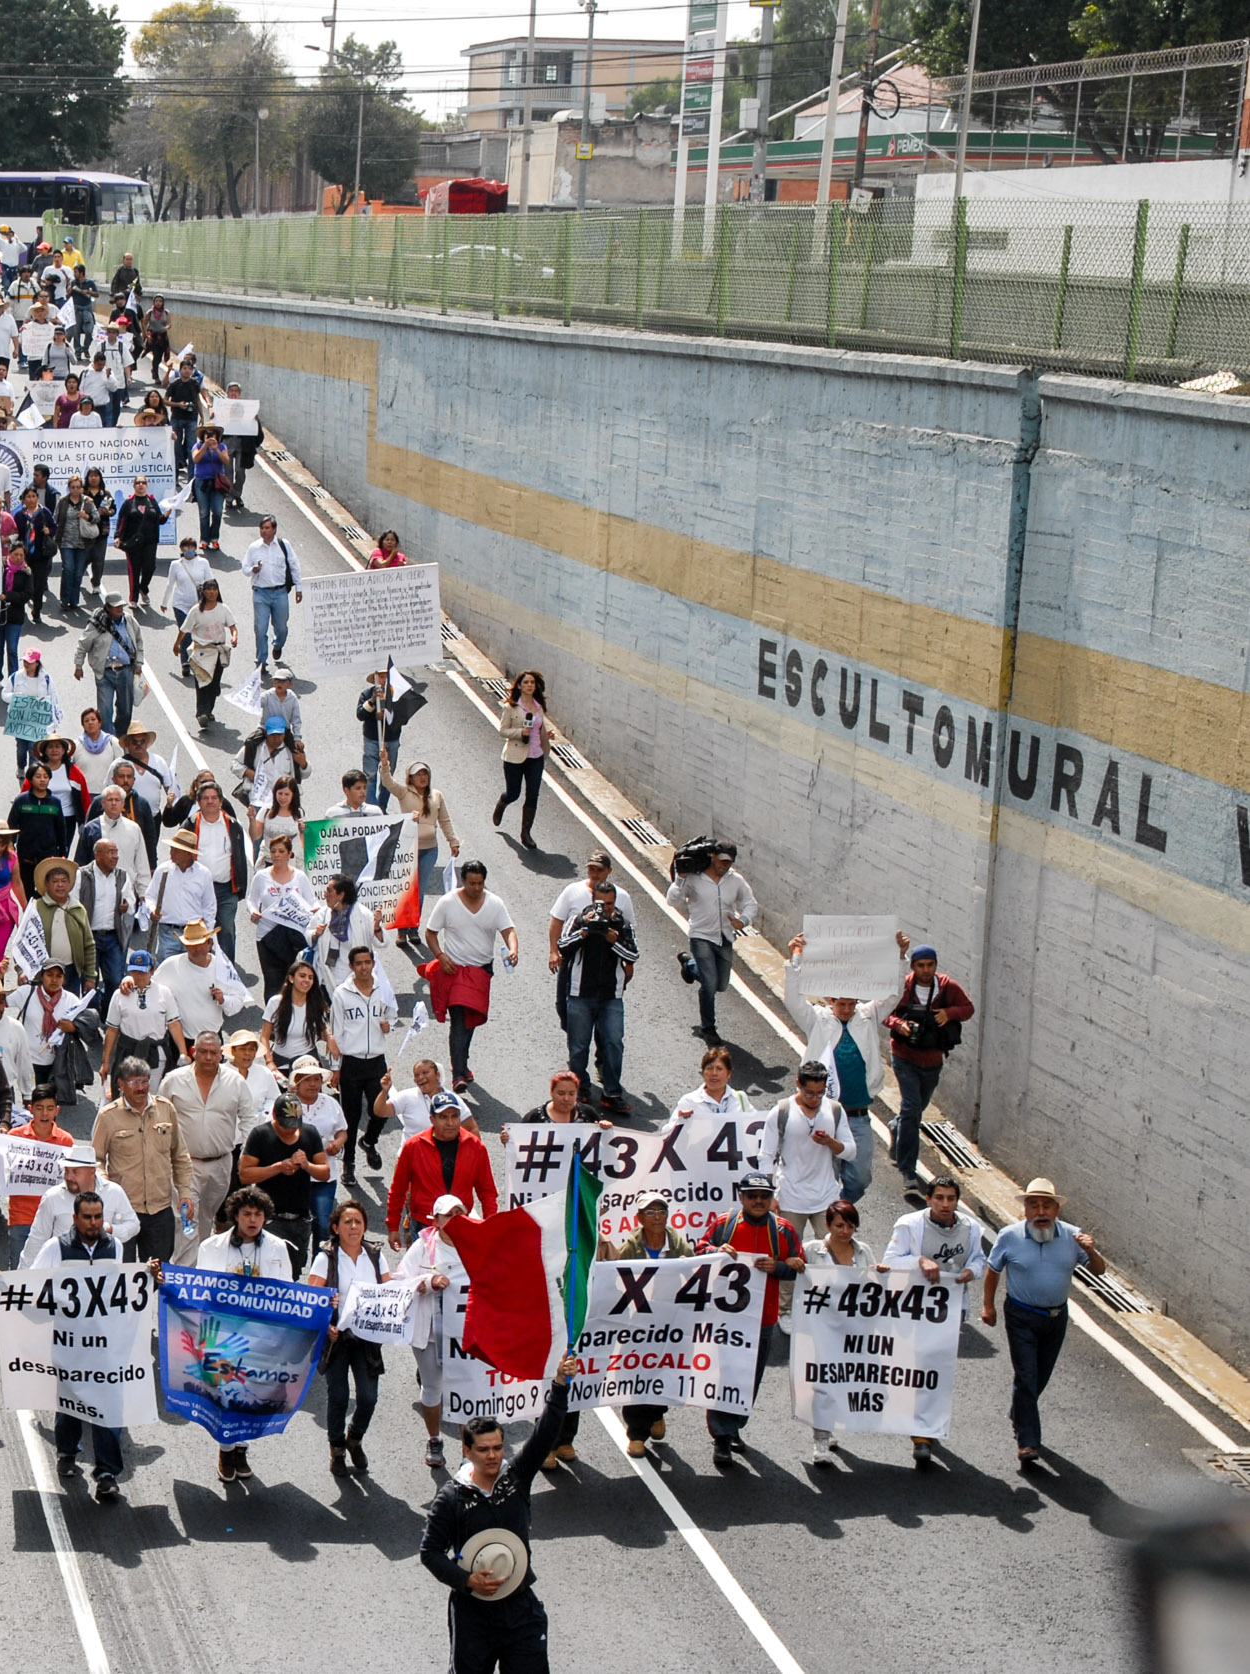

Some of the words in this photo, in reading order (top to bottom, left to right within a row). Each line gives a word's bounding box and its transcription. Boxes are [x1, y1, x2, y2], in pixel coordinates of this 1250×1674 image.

[897, 138, 924, 152] PEMEX
[32, 440, 94, 449] MOVIMIENTO
[100, 439, 150, 448] NACIONAL
[33, 454, 52, 462] POR
[58, 454, 70, 462] LA
[139, 452, 144, 460] Y
[110, 465, 124, 474] DE
[129, 464, 172, 473] JUSTICIA
[396, 572, 404, 580] AL
[9, 710, 24, 721] CON
[757, 638, 1168, 854] ESCULTOMURAL
[316, 844, 330, 856] SER
[308, 860, 329, 871] CADA
[404, 882, 410, 891] O
[32, 1146, 55, 1160] Libertad
[516, 1131, 564, 1182] #
[576, 1132, 638, 1180] 43
[650, 1124, 686, 1174] X
[25, 1160, 35, 1171] 43
[44, 1162, 54, 1174] 43
[0, 1271, 148, 1319] #43X43
[164, 1271, 238, 1292] ESTAMOS
[244, 1281, 329, 1308] APOYANDO
[608, 1267, 660, 1316] X
[675, 1263, 751, 1313] 43
[178, 1287, 188, 1299] A
[193, 1289, 212, 1302] LA
[217, 1292, 314, 1319] COMUNIDAD
[372, 1304, 380, 1318] 43
[388, 1304, 398, 1318] 43
[53, 1329, 74, 1348] Ni
[82, 1333, 108, 1348] un
[692, 1323, 752, 1348] Más.
[844, 1334, 862, 1354] NI
[868, 1335, 894, 1356] UN
[9, 1358, 146, 1384] desaparecido
[203, 1352, 300, 1385] Estamos
[608, 1350, 712, 1372] ZÓCALO
[806, 1362, 939, 1390] DESAPARECIDO
[59, 1396, 104, 1418] más.
[450, 1391, 526, 1418] Domingo
[530, 1387, 539, 1406] 9
[570, 1374, 664, 1400] Noviembre
[678, 1375, 696, 1398] 11
[704, 1382, 744, 1406] a.m.
[848, 1389, 884, 1412] MÁS
